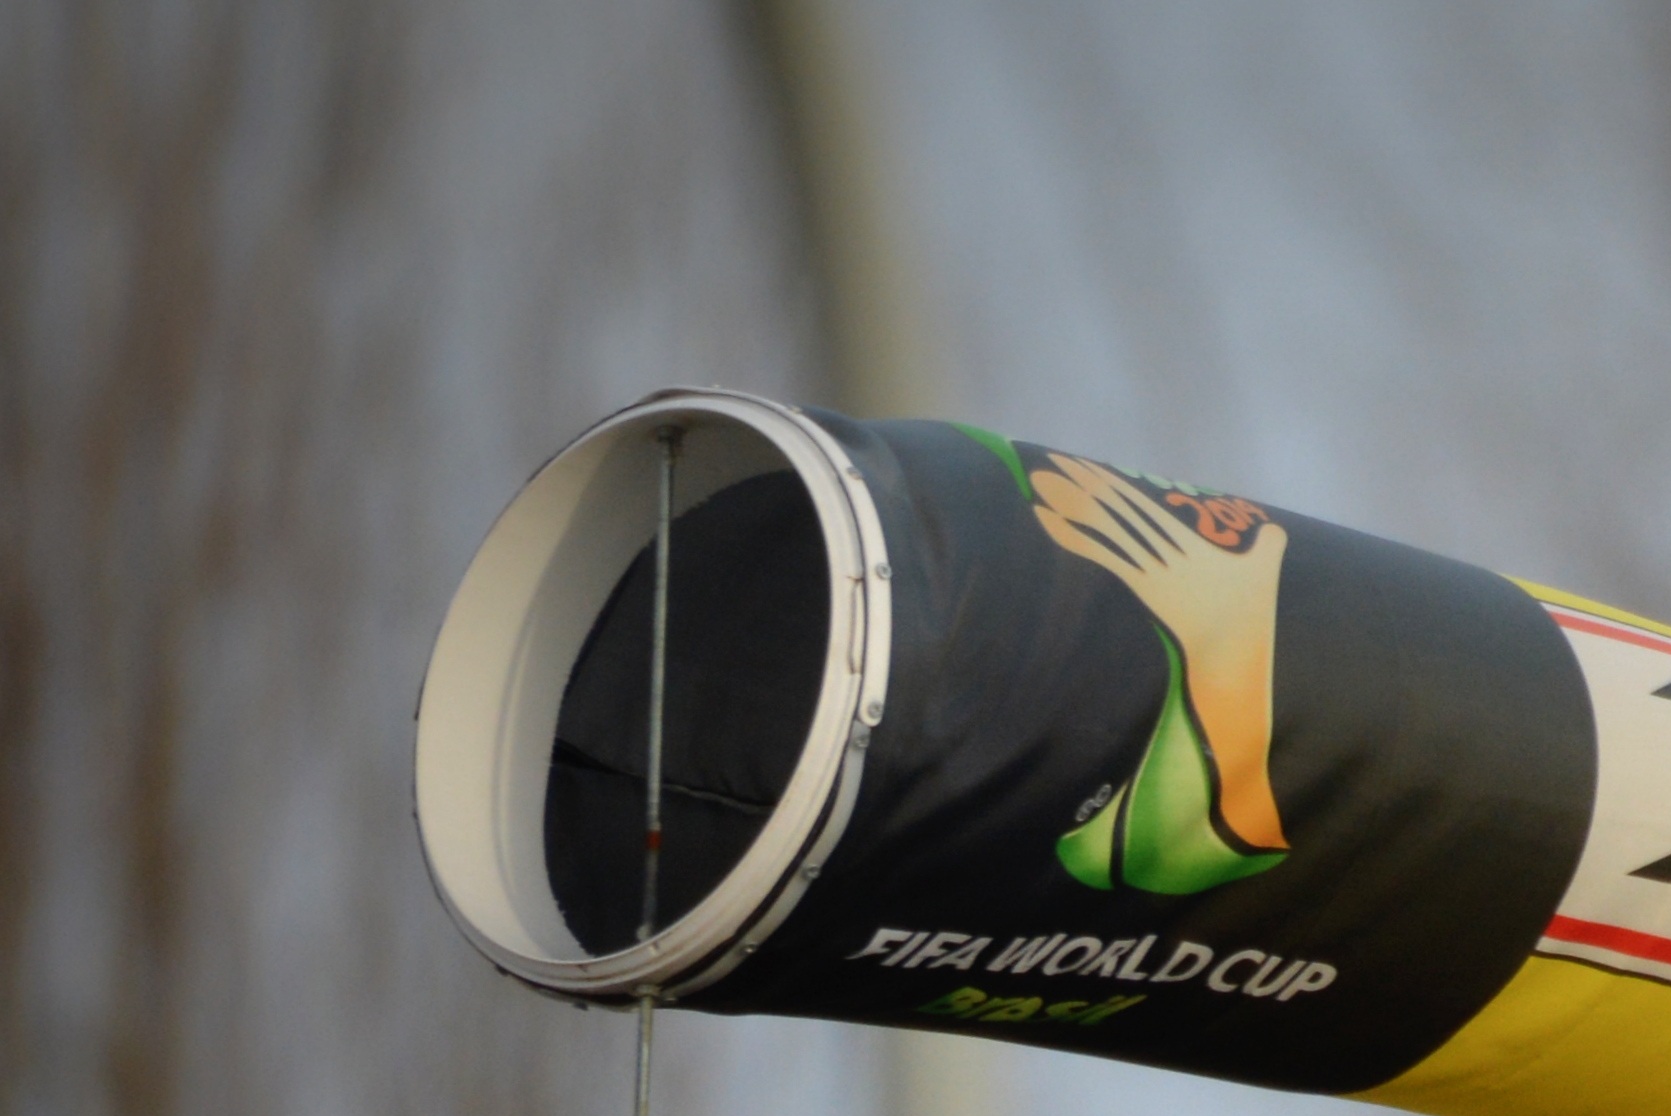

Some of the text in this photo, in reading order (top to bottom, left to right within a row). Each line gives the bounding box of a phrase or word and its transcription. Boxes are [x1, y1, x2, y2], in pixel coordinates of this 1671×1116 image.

[846, 927, 1338, 1002] FIFA WORLD CUP
